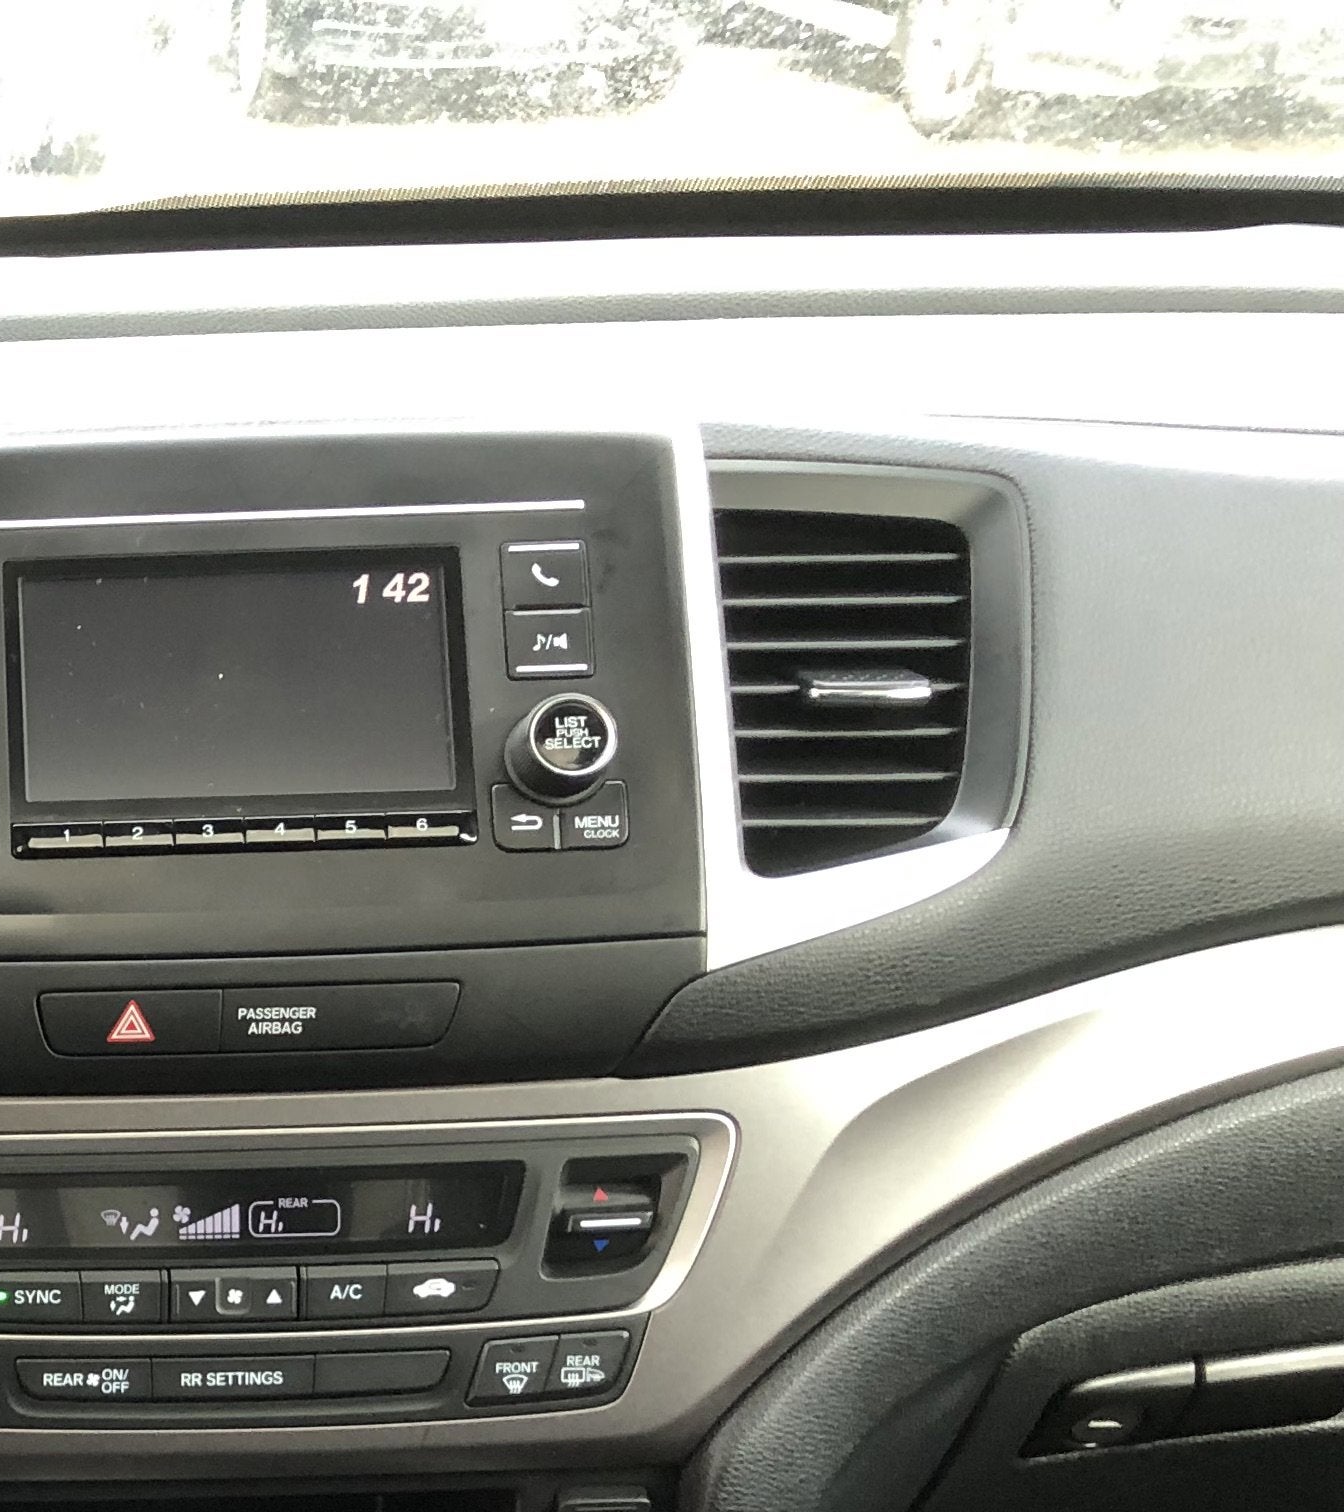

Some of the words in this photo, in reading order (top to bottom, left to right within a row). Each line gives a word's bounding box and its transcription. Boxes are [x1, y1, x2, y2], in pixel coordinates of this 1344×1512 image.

[554, 715, 588, 729] LIST
[556, 727, 589, 738] PUSH
[544, 736, 602, 750] SELECT
[273, 821, 286, 836] 4
[345, 819, 357, 834] 5
[416, 817, 428, 832] 6
[574, 815, 620, 829] MENU
[63, 829, 72, 842] 1
[131, 827, 144, 841] 2
[202, 824, 215, 838] 3
[583, 828, 620, 839] CLOCK
[238, 1006, 317, 1020] PASSENGER
[248, 1021, 303, 1035] AIRBAG
[278, 1196, 309, 1210] REAR
[104, 1284, 141, 1295] MODE
[330, 1284, 363, 1301] A/C
[14, 1289, 63, 1305] SYNC
[496, 1361, 538, 1374] FRONT
[566, 1355, 600, 1368] REAR
[43, 1372, 84, 1387] REAR
[102, 1368, 129, 1381] ON/
[180, 1372, 203, 1387] RR
[206, 1370, 284, 1387] SETTINGS
[101, 1381, 129, 1394] OFF
